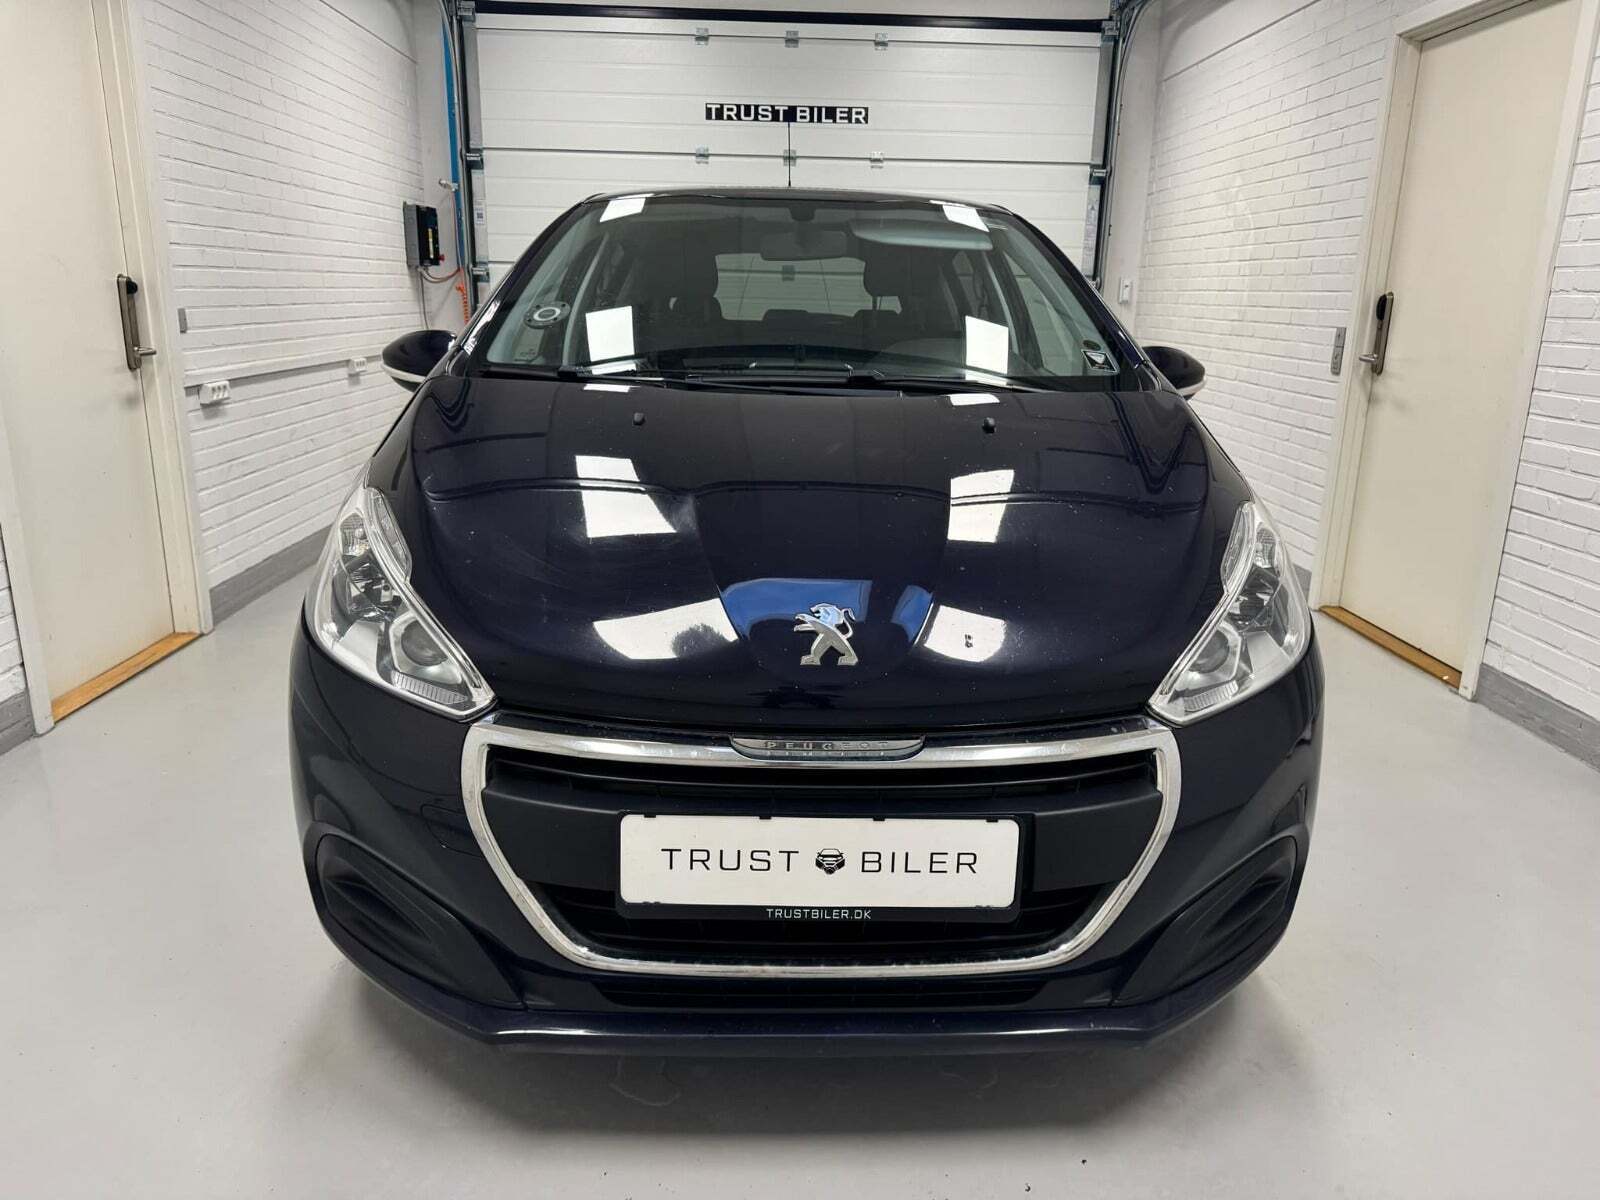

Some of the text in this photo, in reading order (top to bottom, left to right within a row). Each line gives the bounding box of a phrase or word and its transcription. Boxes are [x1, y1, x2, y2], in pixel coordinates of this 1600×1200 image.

[706, 103, 866, 123] TRUST BILER
[661, 848, 978, 874] TRUST BILER
[766, 908, 872, 920] TRUSTBILER.DK
